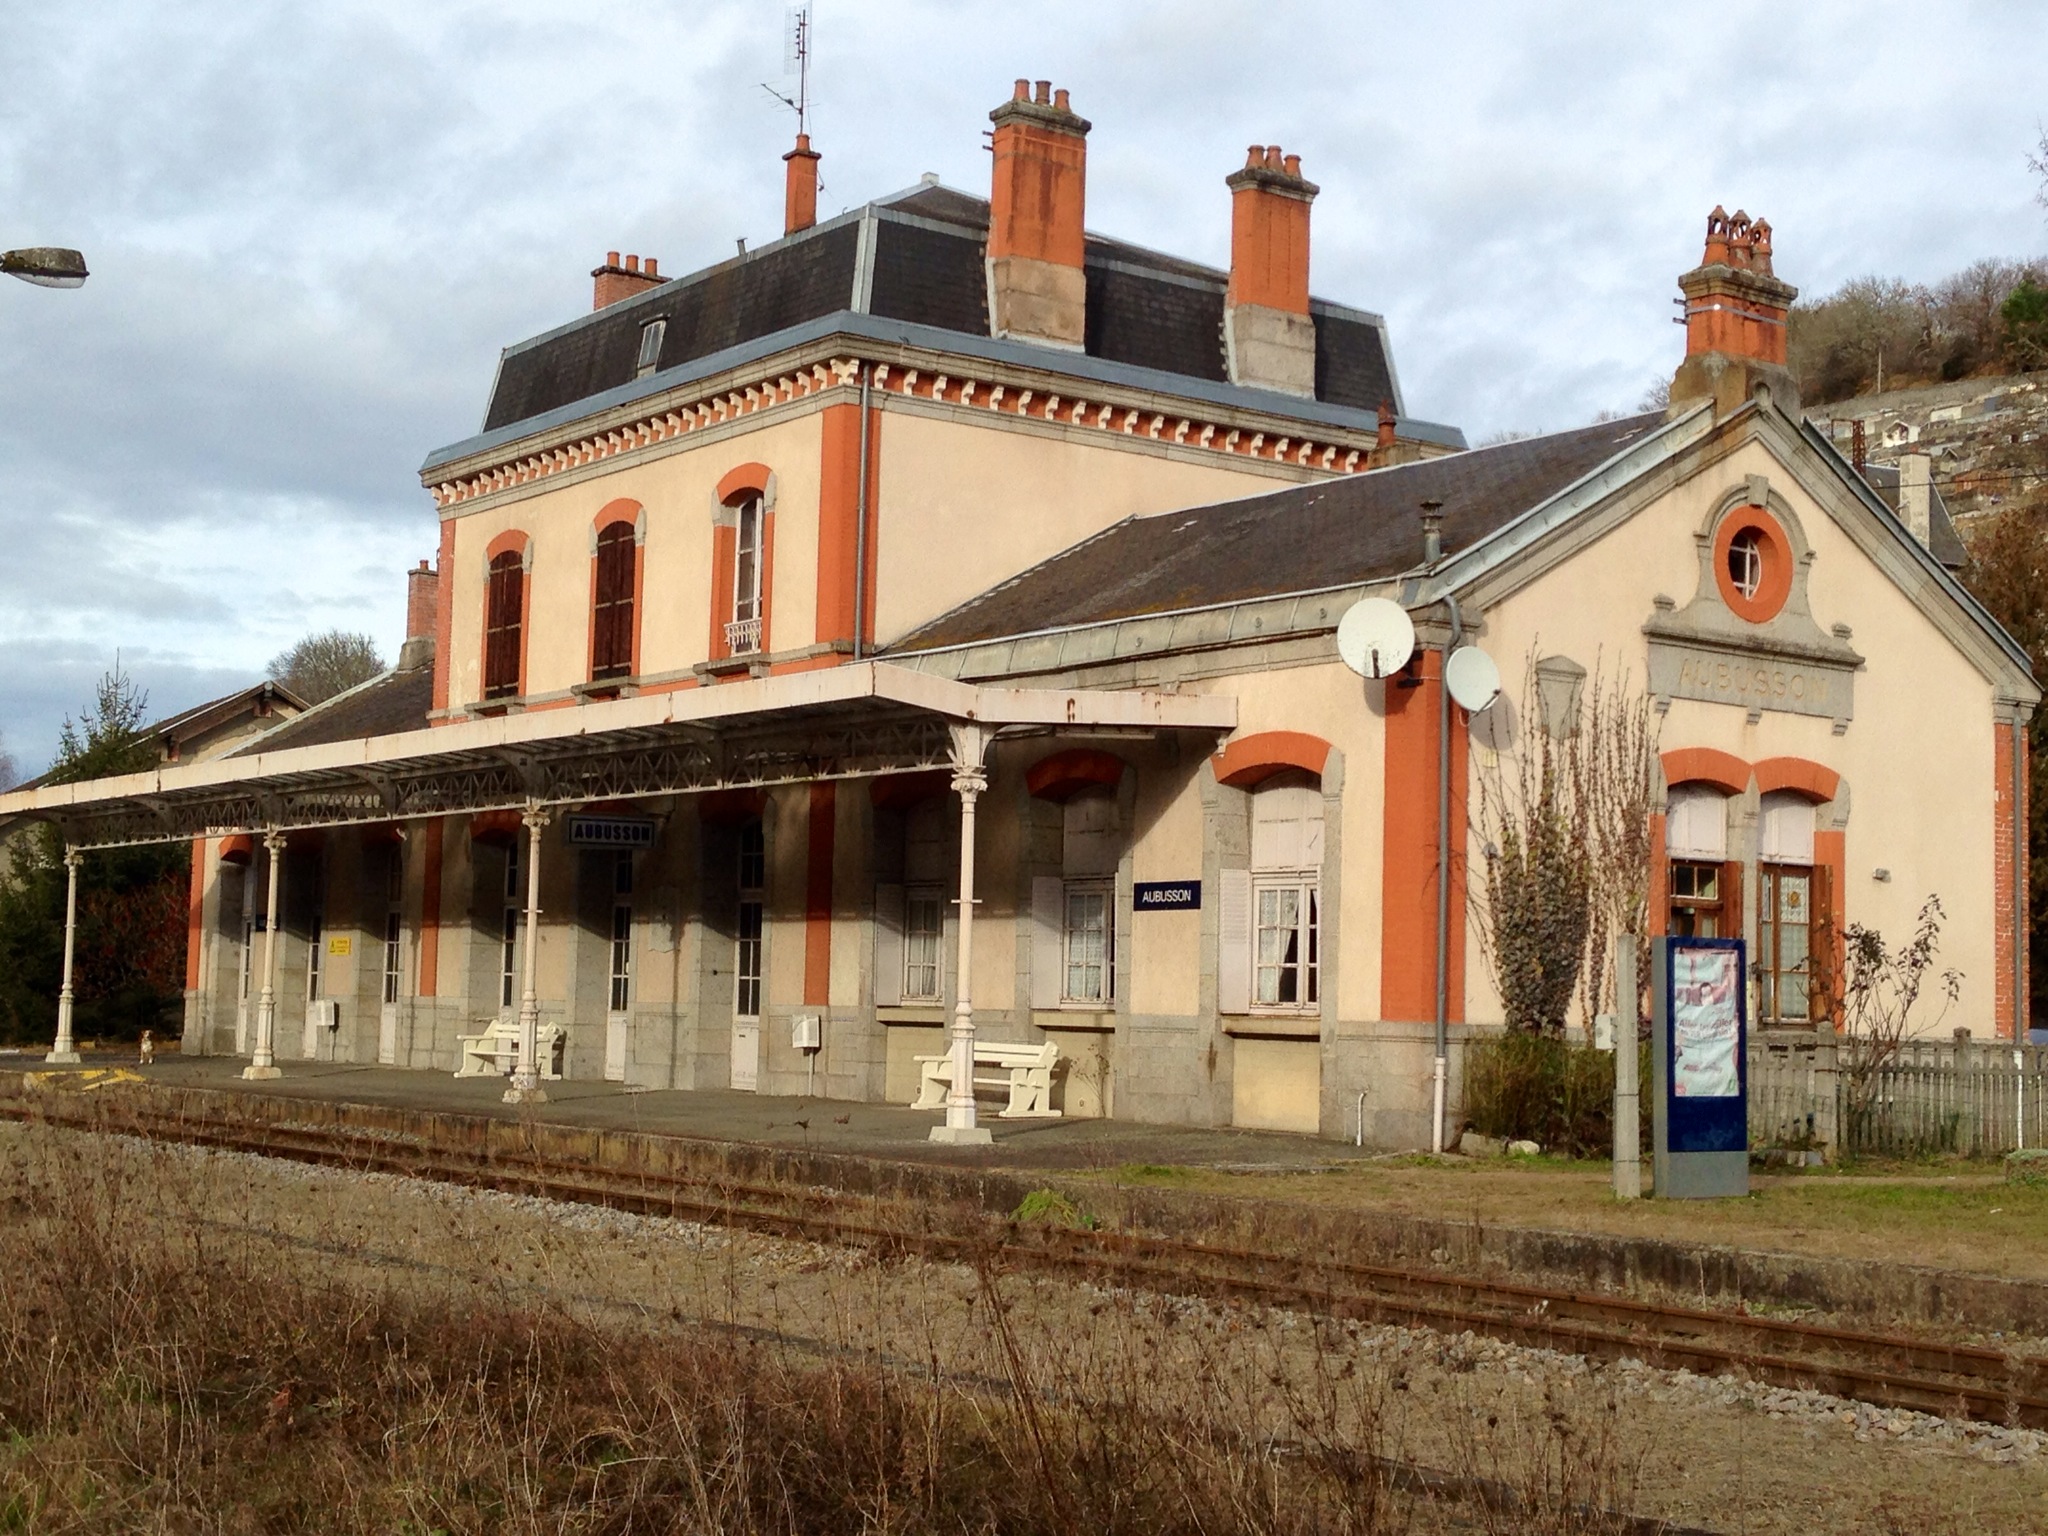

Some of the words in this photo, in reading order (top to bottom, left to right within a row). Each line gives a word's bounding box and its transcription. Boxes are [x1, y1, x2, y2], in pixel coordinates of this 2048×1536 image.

[1678, 658, 1830, 702] AUBUSSON
[574, 824, 650, 841] AUBUSSON
[1142, 889, 1192, 903] AUBUSSON
